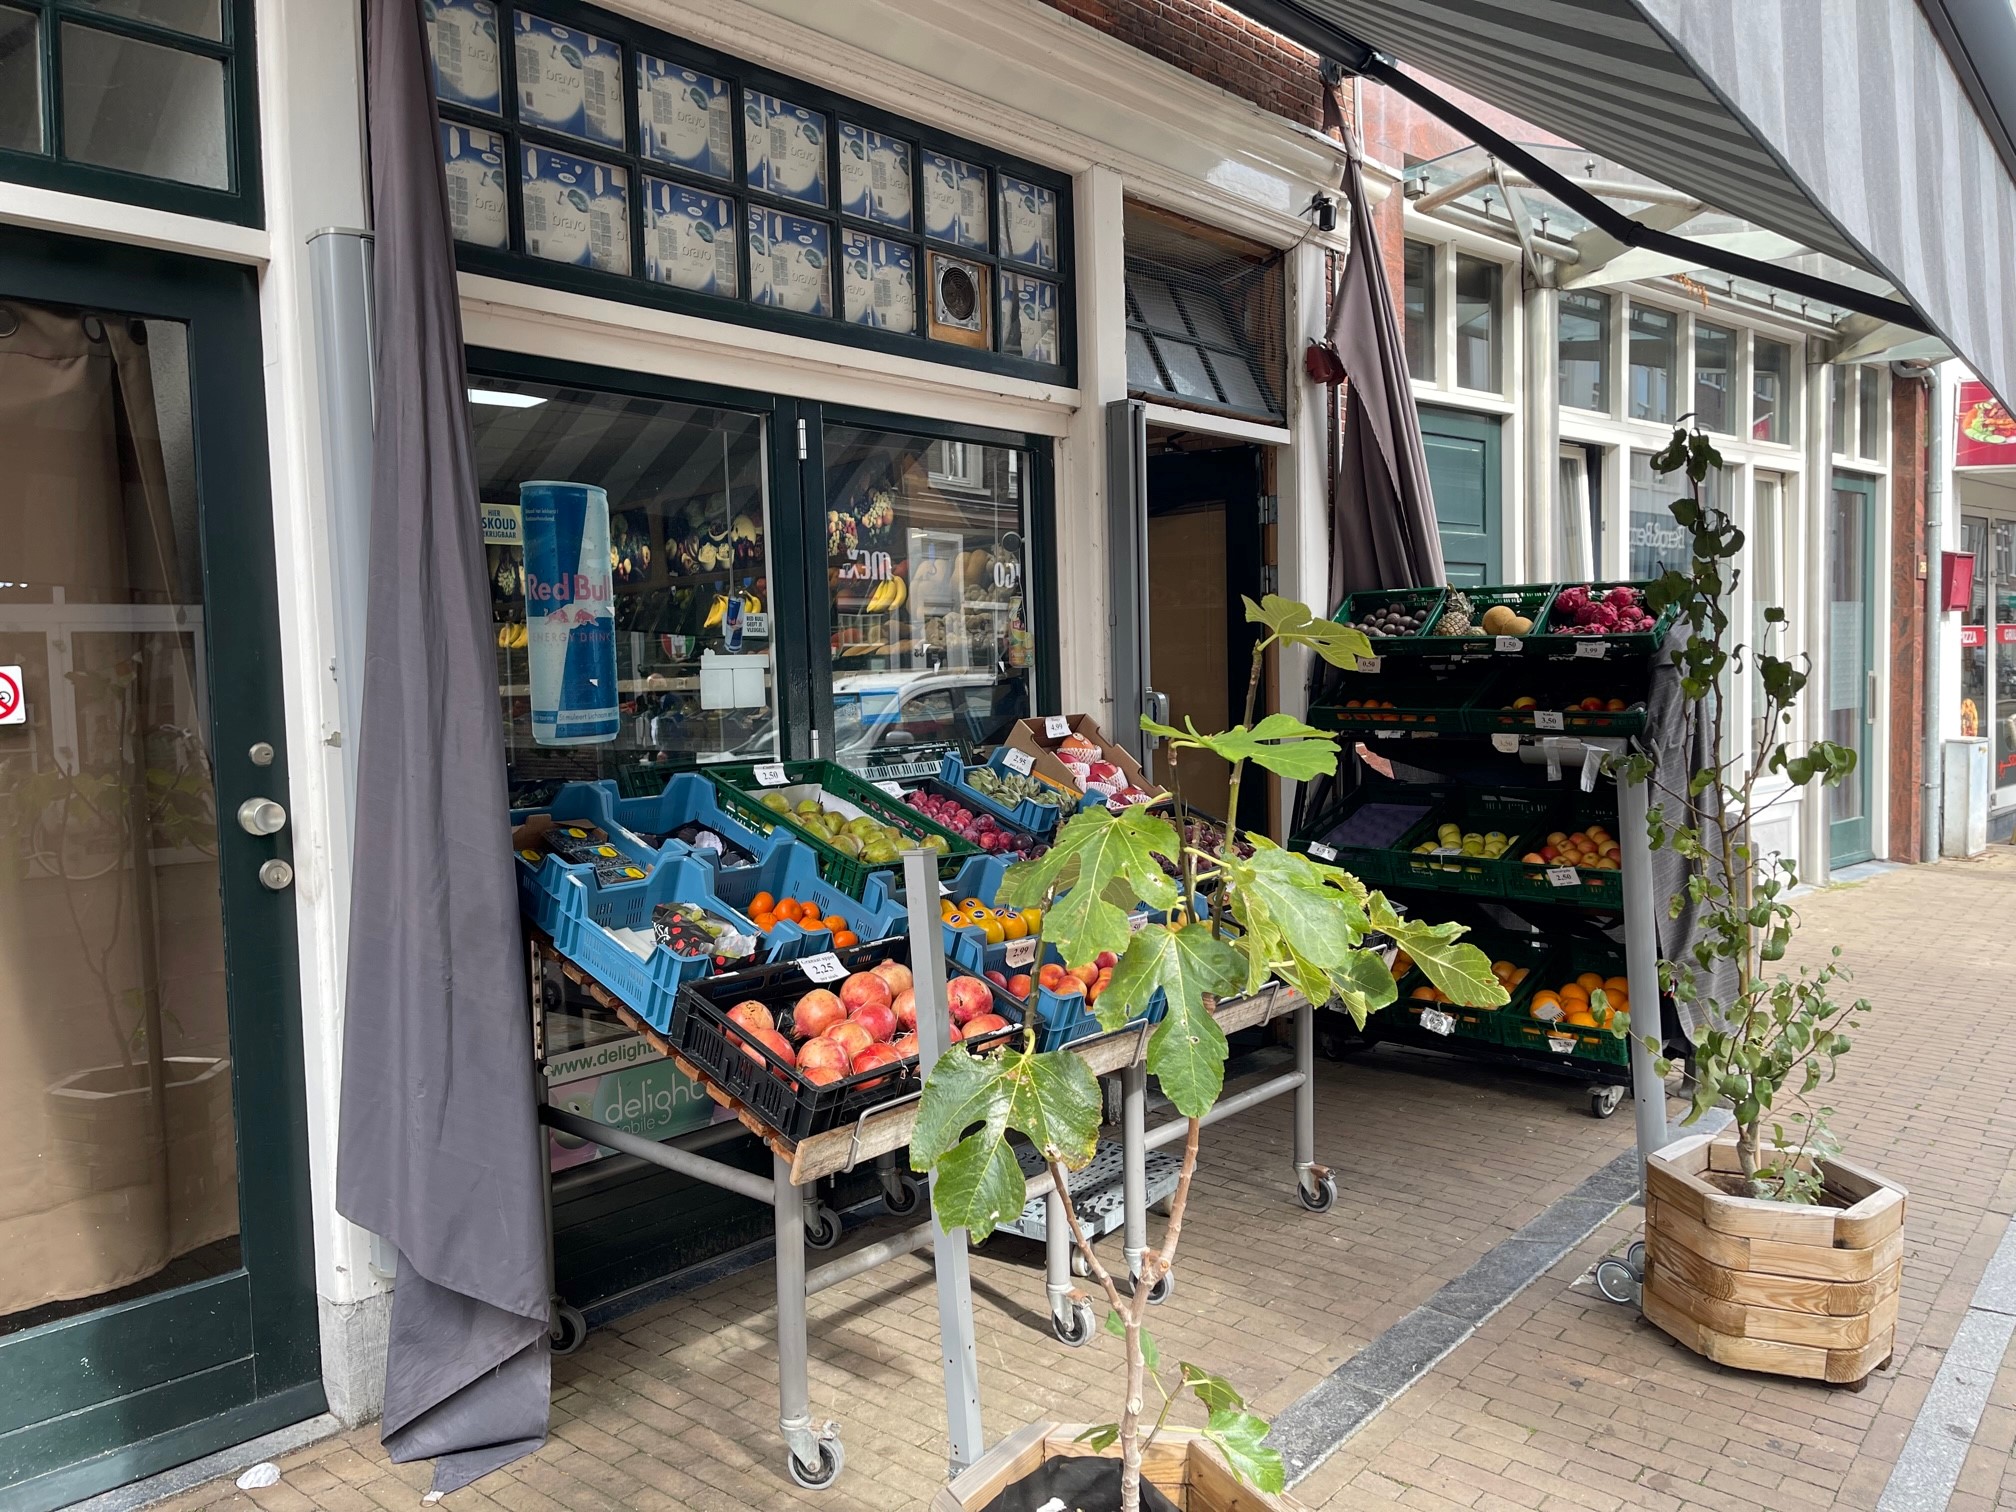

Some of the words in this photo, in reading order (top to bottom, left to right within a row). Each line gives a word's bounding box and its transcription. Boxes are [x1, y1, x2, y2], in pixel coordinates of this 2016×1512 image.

[552, 211, 586, 232] bravo
[527, 572, 570, 601] Red
[574, 574, 612, 601] Bull
[532, 632, 575, 642] ENERGY
[579, 632, 611, 642] DRINK
[812, 962, 835, 975] 2,25
[605, 1072, 705, 1125] delight
[617, 1116, 656, 1135] obile
